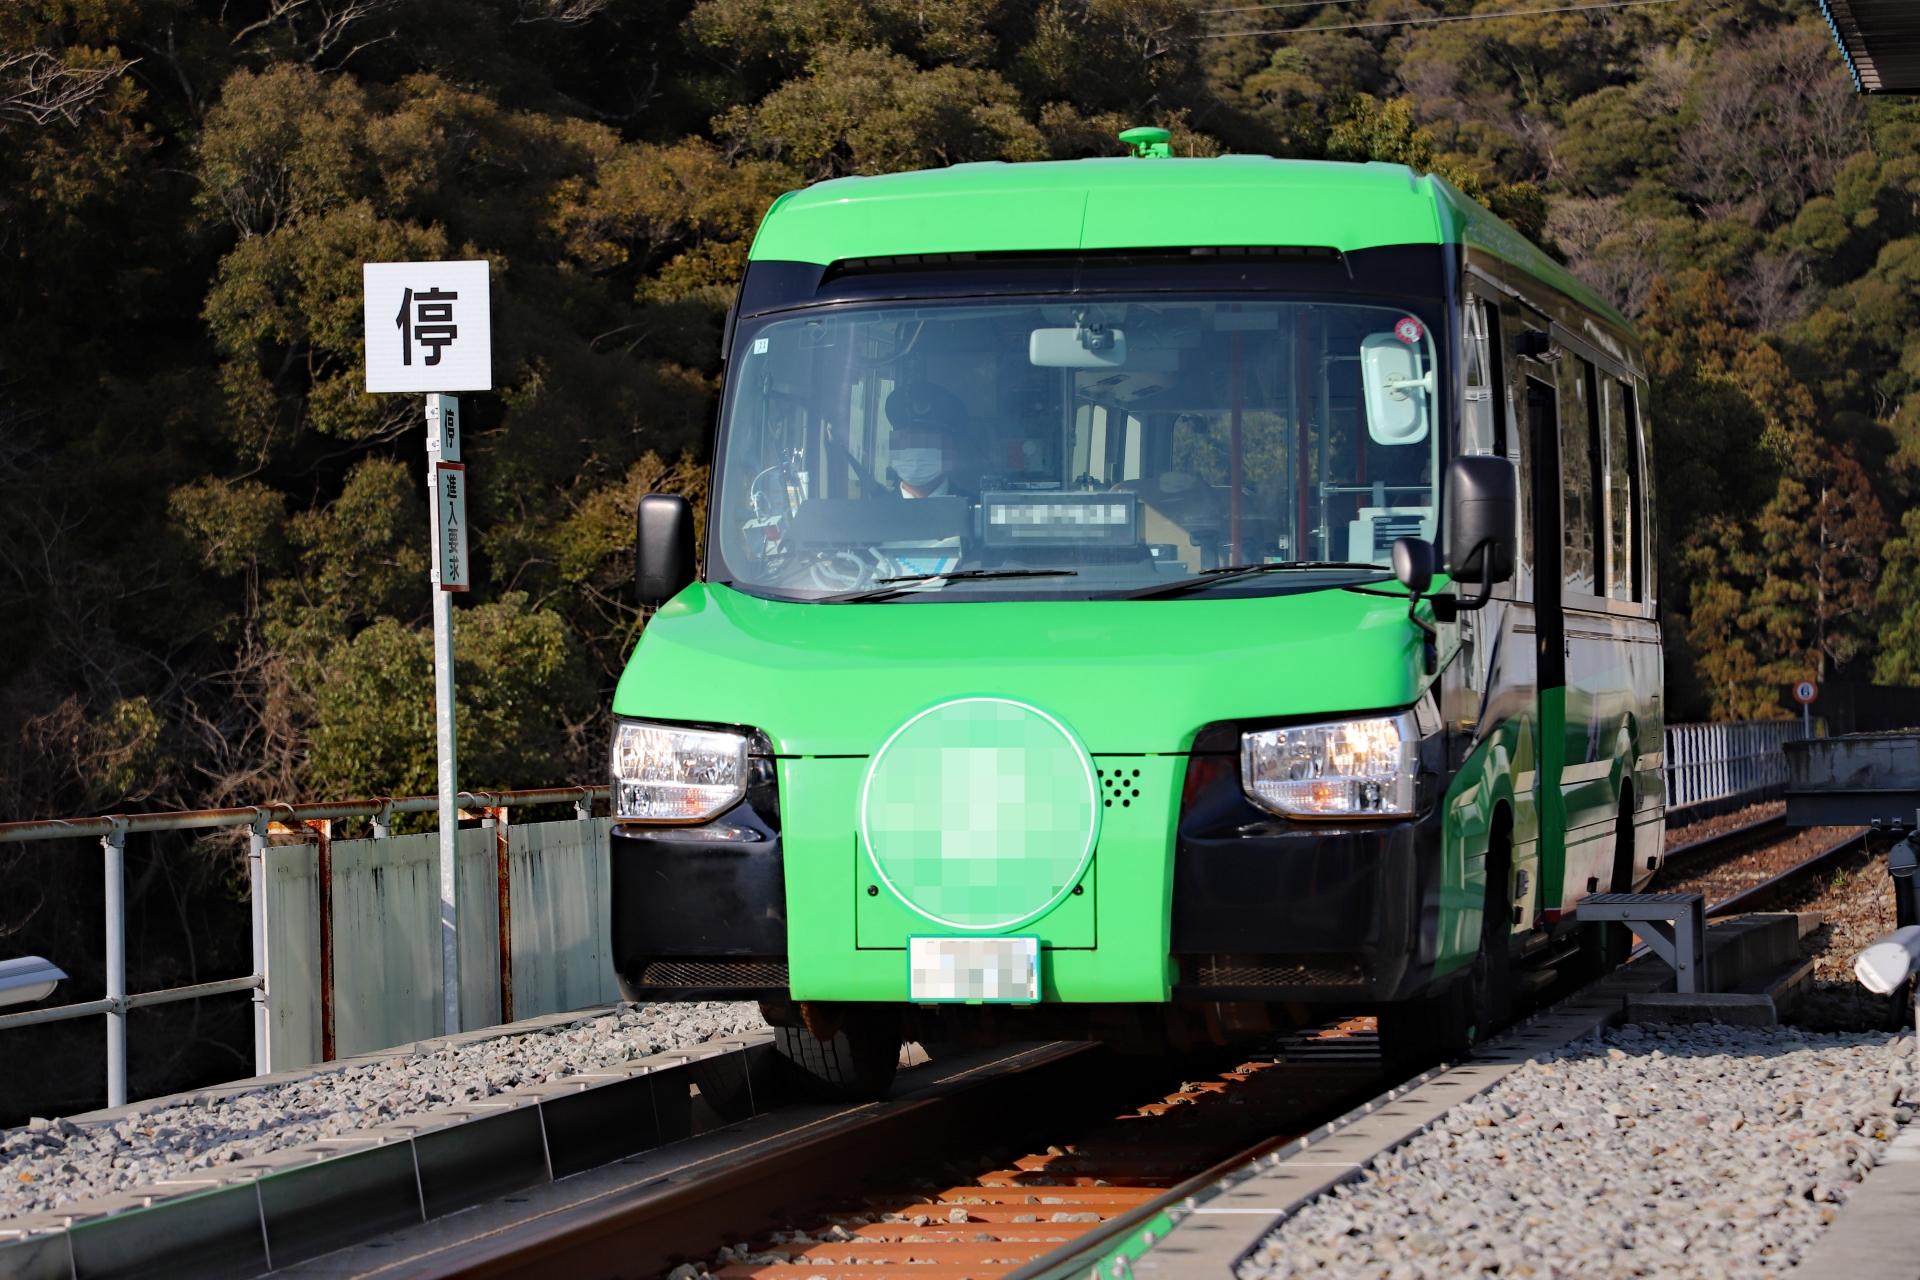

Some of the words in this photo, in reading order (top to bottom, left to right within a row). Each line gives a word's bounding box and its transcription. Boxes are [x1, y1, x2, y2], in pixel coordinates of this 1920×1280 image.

[396, 286, 458, 366] 停
[444, 408, 455, 448] 停
[446, 473, 460, 581] 進入要求
[1801, 685, 1810, 698] 6
